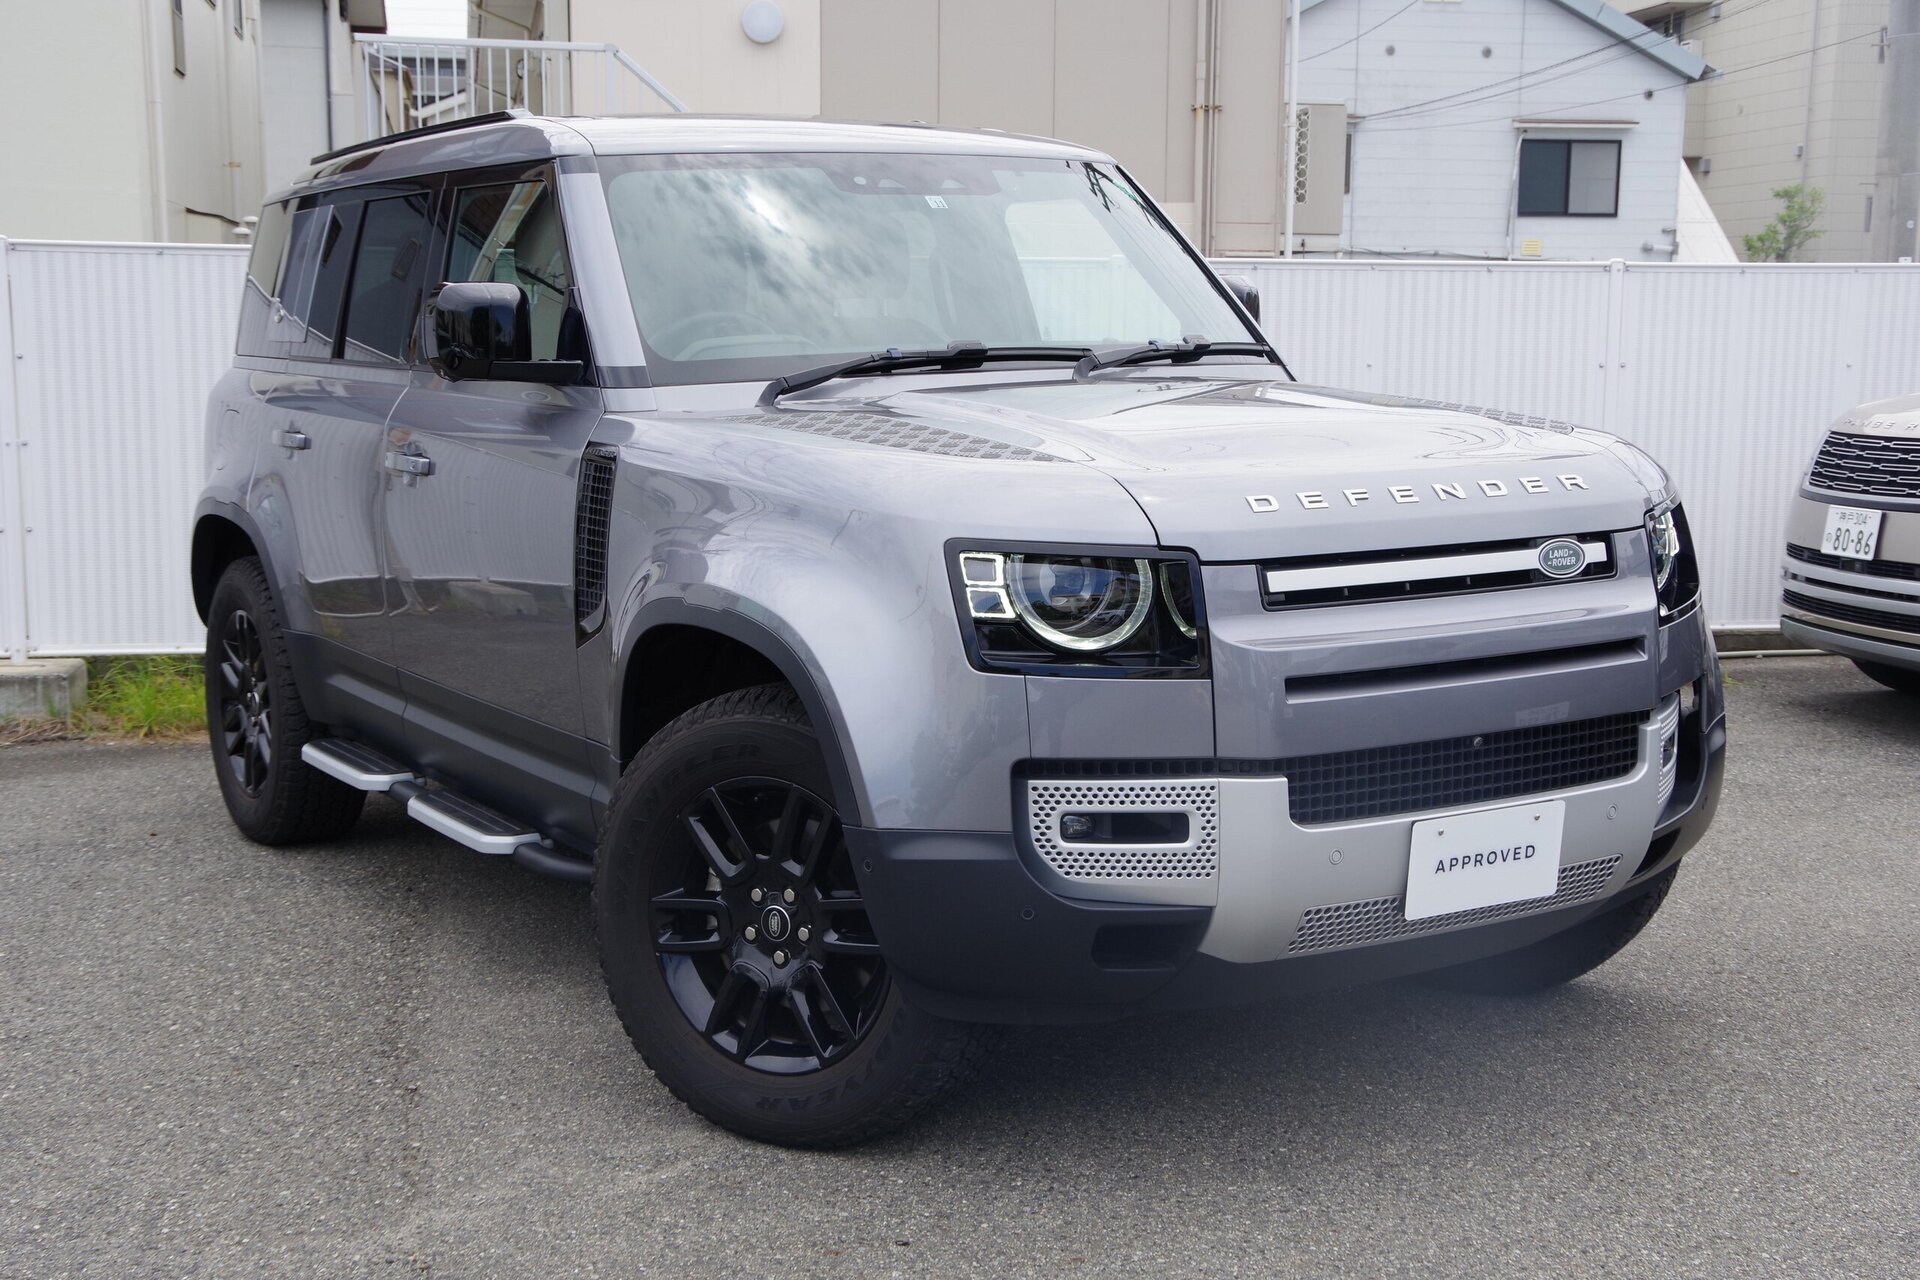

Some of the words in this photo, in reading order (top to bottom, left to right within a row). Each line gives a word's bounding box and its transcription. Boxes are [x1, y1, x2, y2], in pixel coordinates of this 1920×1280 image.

[1245, 474, 1590, 514] DEFENDER
[1549, 549, 1569, 559] LAND
[1552, 556, 1576, 567] ROVER
[1434, 844, 1537, 875] APPROVED
